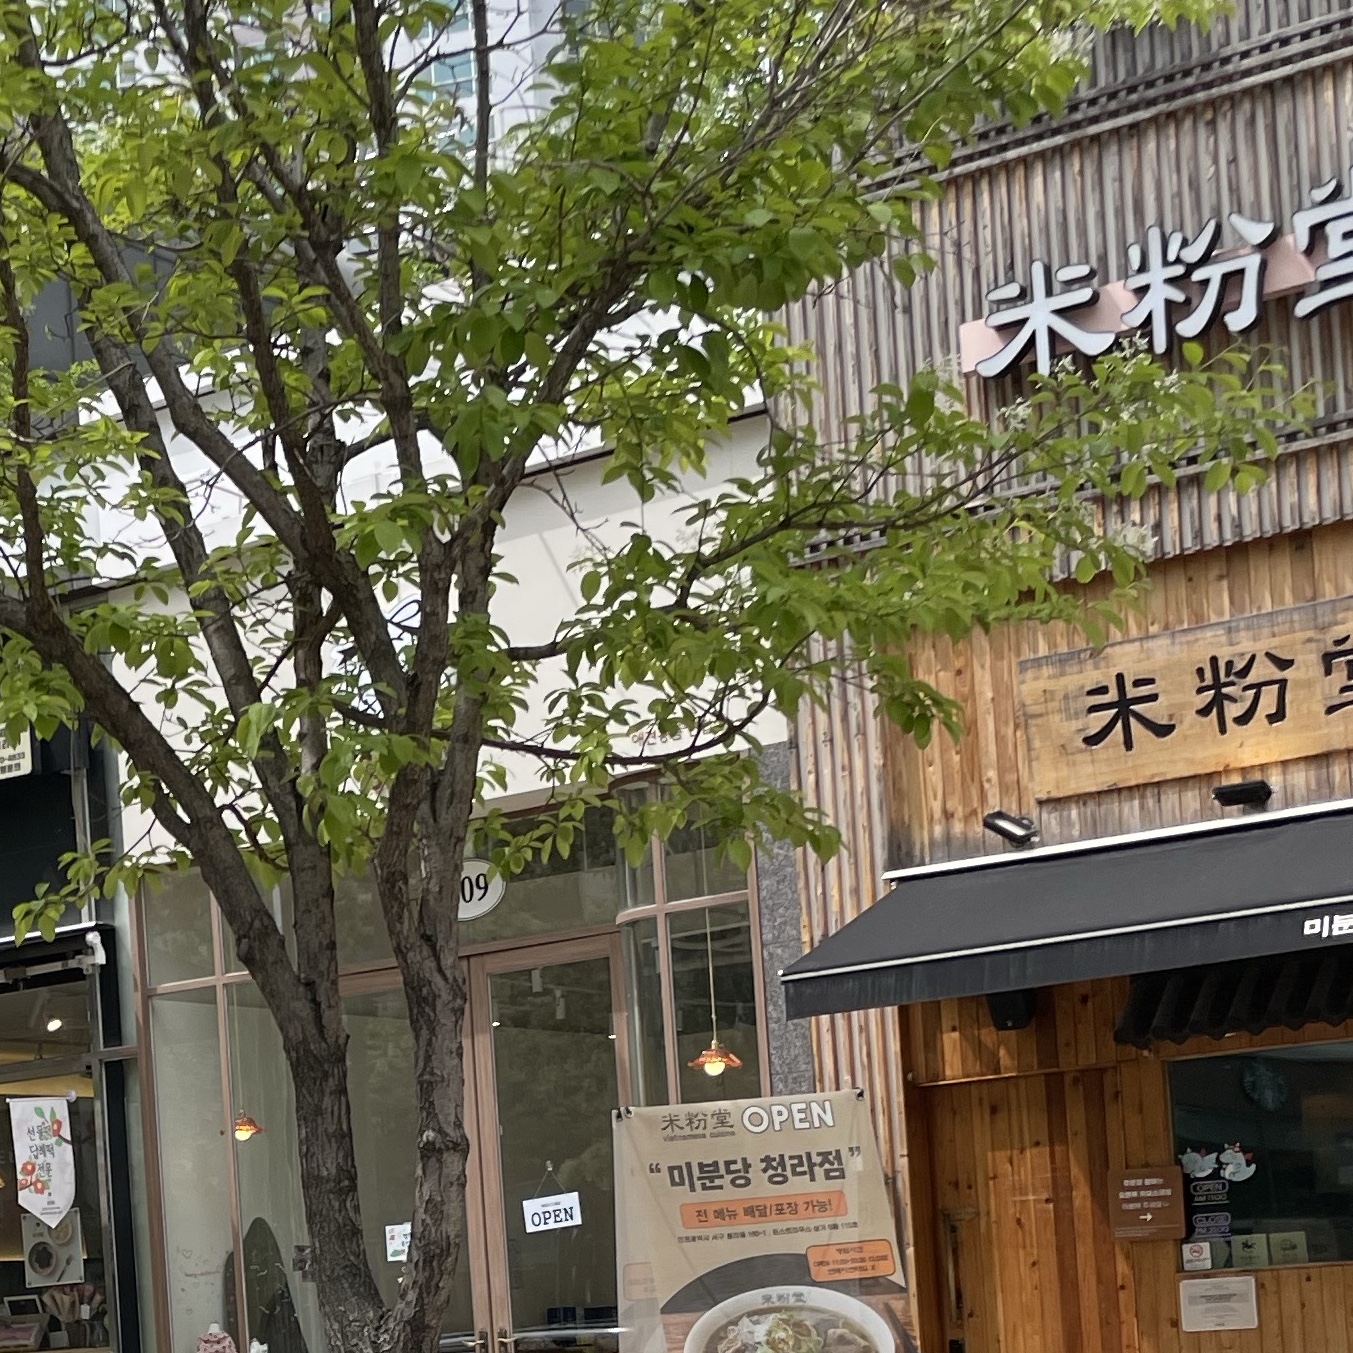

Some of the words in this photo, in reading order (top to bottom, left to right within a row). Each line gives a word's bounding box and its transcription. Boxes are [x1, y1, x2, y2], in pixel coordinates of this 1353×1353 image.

[661, 1107, 735, 1133] 米粉堂
[742, 1099, 836, 1135] OPEN
[531, 1206, 574, 1227] OPEN
